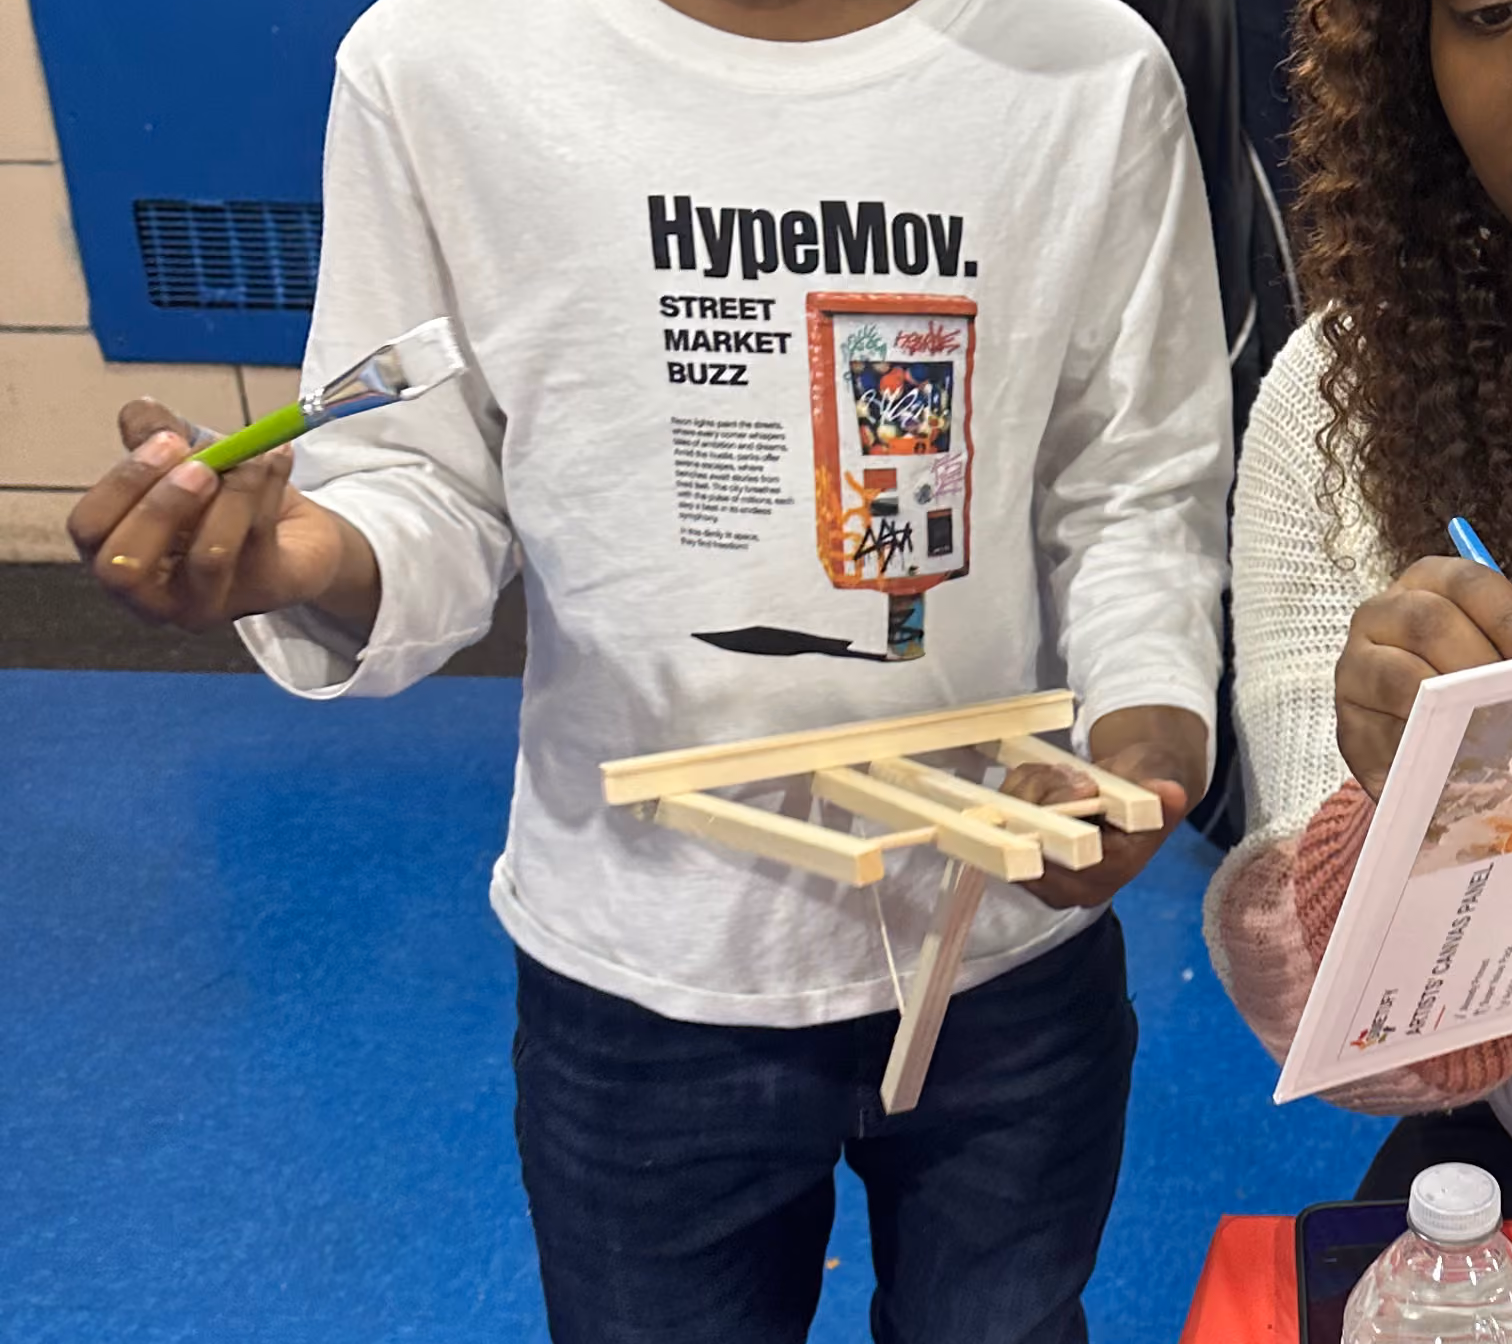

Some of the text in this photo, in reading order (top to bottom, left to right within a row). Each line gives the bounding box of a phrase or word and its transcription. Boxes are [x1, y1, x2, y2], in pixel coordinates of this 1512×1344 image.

[648, 195, 978, 281] HypeMov.
[660, 295, 776, 321] STREET
[664, 328, 792, 354] MARKET
[667, 362, 749, 387] BUZZ
[1432, 916, 1471, 975] CANVAS
[1457, 862, 1494, 915] PANEL
